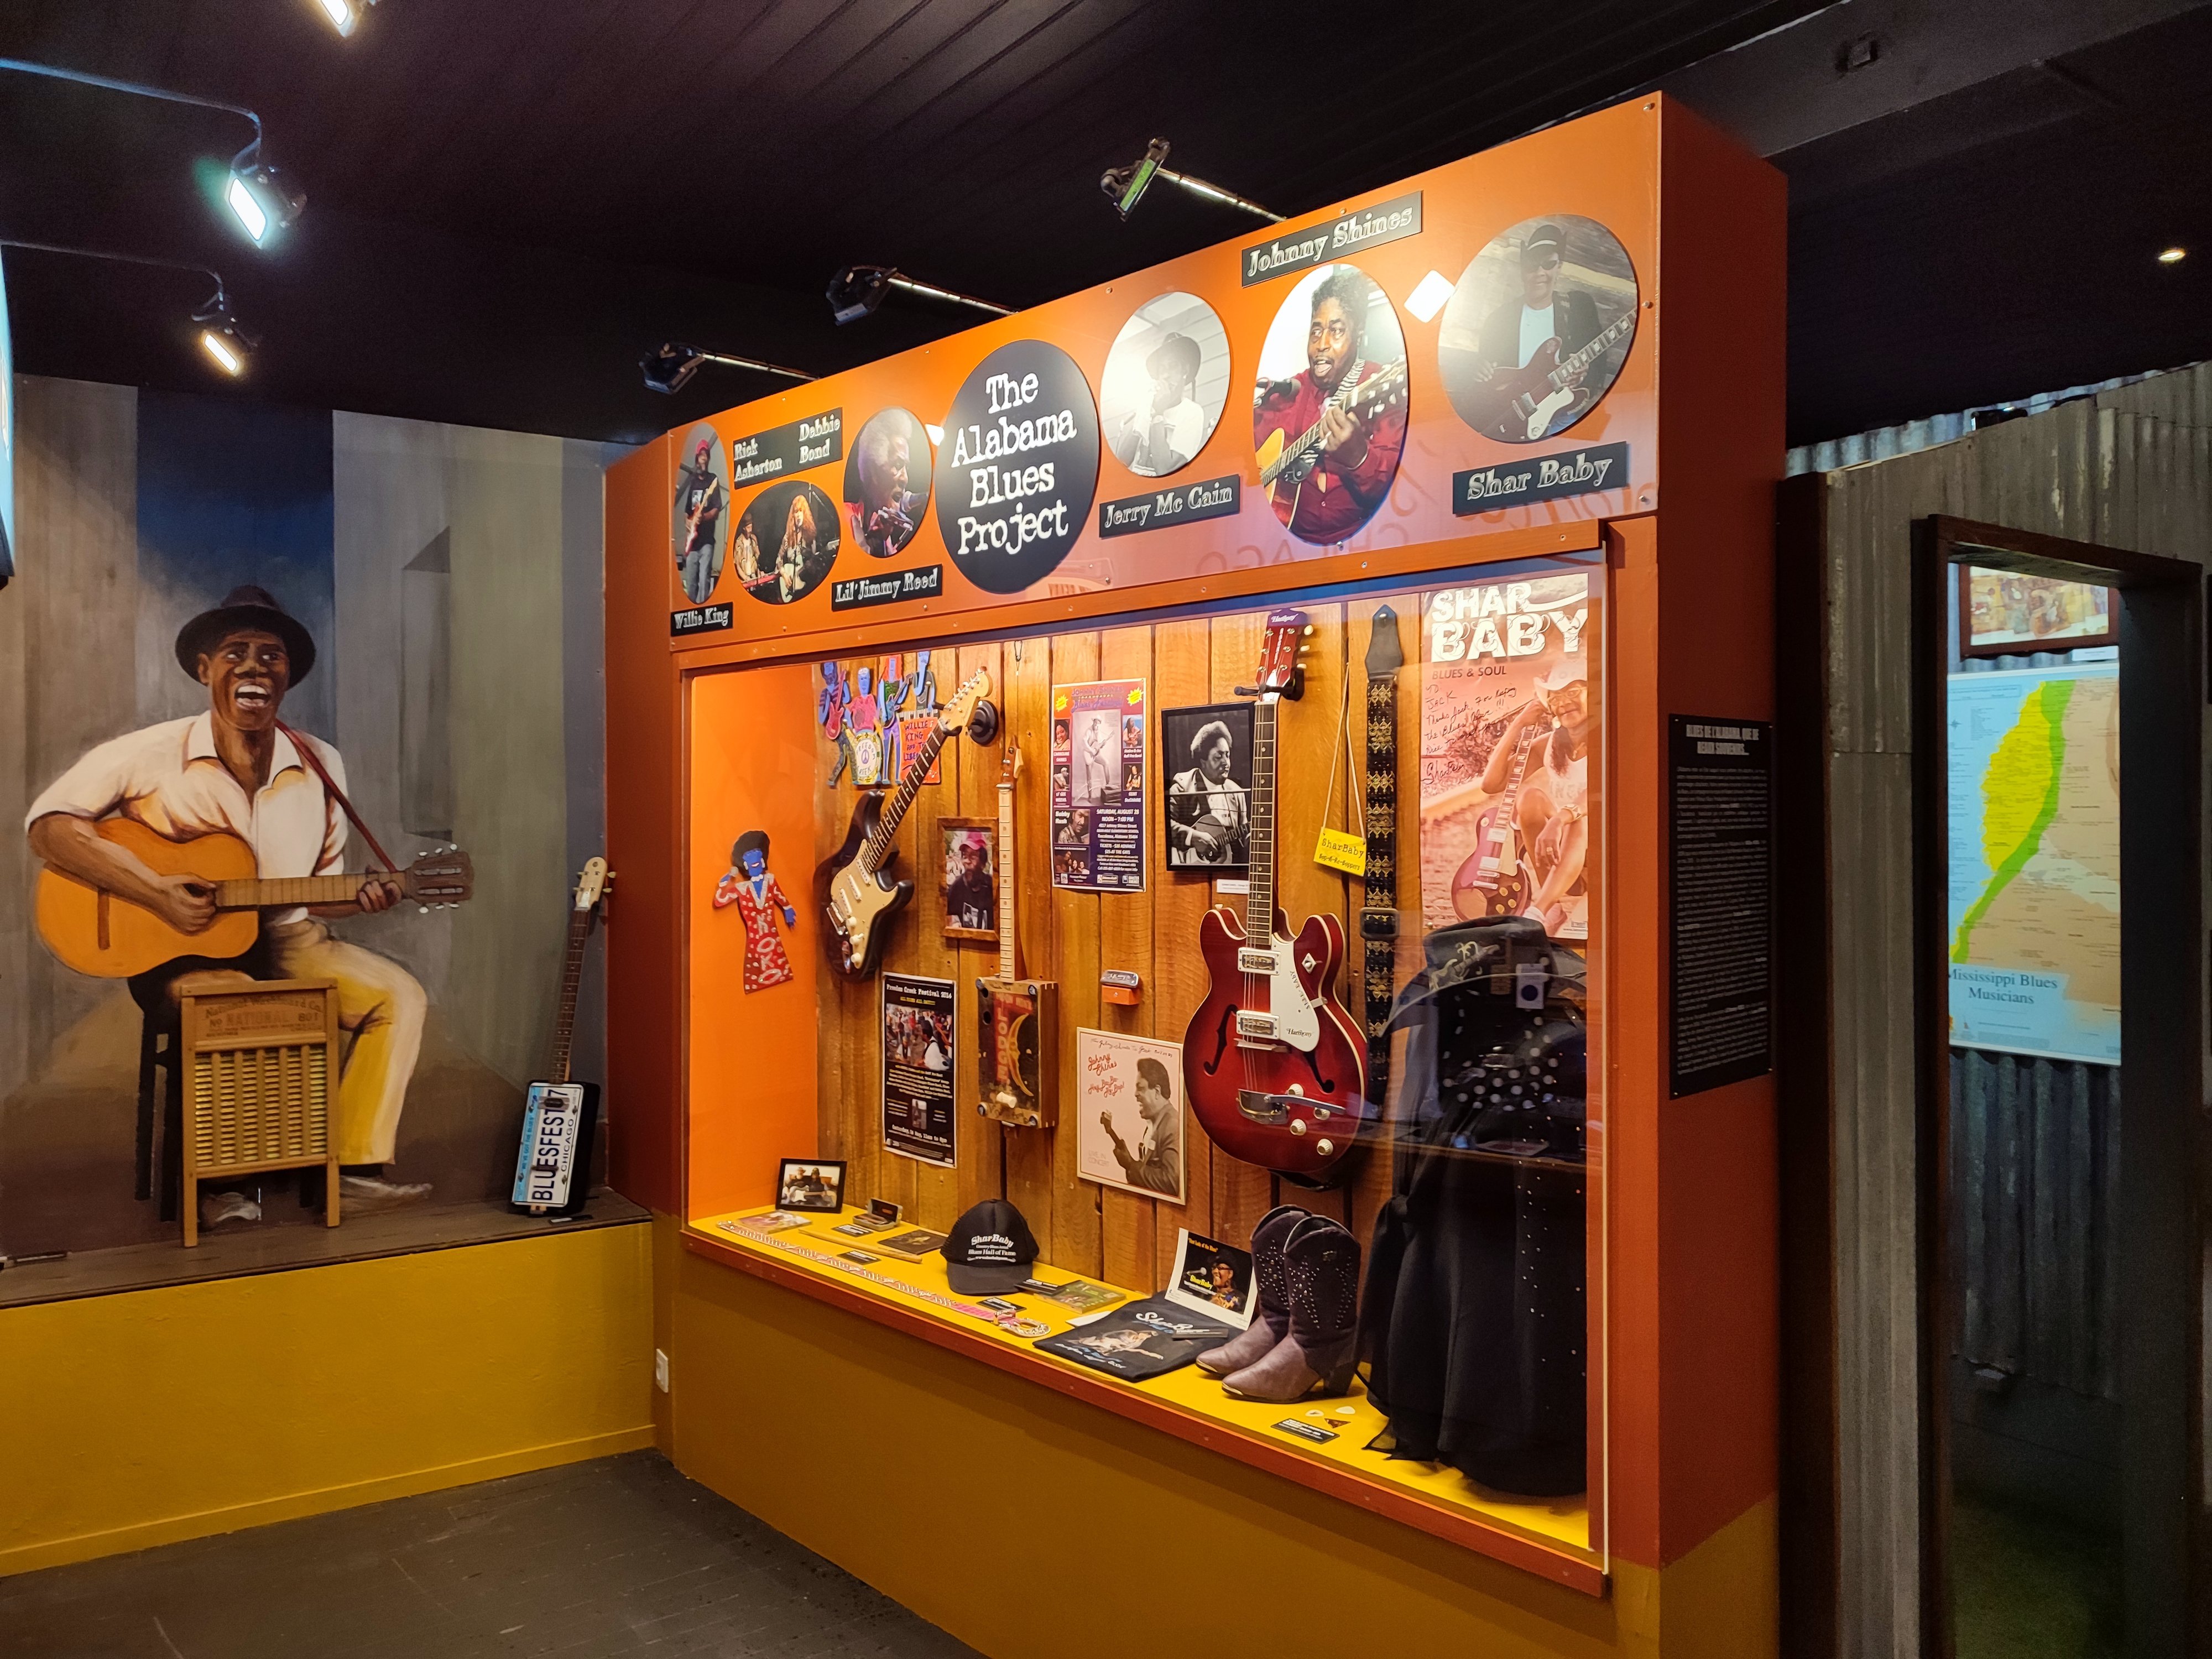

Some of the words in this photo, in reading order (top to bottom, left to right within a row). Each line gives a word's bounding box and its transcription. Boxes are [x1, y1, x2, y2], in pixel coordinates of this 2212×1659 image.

[1246, 232, 1328, 277] Johnny
[1332, 206, 1413, 248] Shines
[984, 372, 1039, 414] The
[799, 414, 841, 442] Debbie
[951, 409, 1078, 468] Alabama
[734, 437, 759, 461] Rick
[799, 437, 831, 463] Bond
[734, 457, 782, 482] Asherton
[1466, 466, 1531, 501] Shar
[1536, 452, 1613, 489] Baby
[969, 462, 1055, 508] Blues
[1104, 503, 1151, 530] Jerry
[1154, 492, 1183, 517] Mc
[1187, 482, 1233, 510] Cain
[957, 499, 1070, 555] Project
[902, 567, 938, 592] Reed
[1431, 582, 1548, 622] SHAR
[674, 612, 703, 629] Willie
[704, 608, 729, 627] King
[1431, 608, 1588, 662] BABY
[1432, 668, 1463, 680] BLUES
[1467, 667, 1474, 677] &
[1478, 665, 1507, 676] SOUL
[905, 721, 928, 730] WILLIE
[906, 731, 924, 742] KING
[1322, 838, 1364, 858] SharBaby
[2020, 974, 2058, 989] Blues
[1969, 987, 2034, 1004] Musicians
[561, 1119, 575, 1172] CHICAGO
[971, 1234, 1014, 1248] SharBaby
